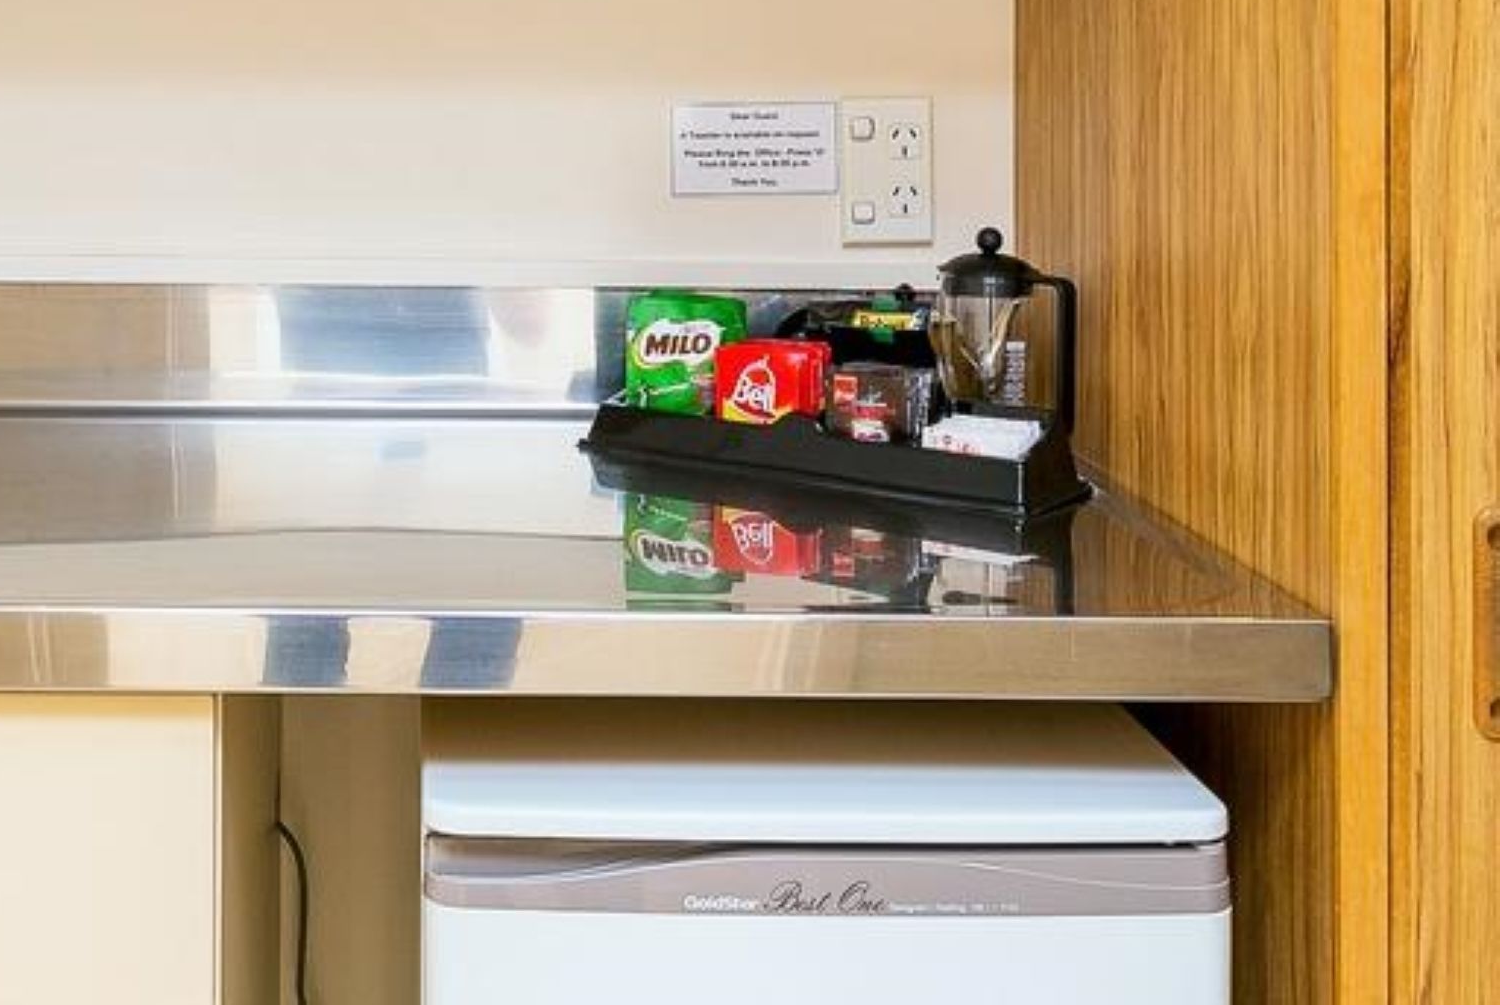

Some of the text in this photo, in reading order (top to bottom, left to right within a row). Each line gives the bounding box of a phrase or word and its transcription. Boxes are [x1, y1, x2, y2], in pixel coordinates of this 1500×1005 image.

[645, 333, 712, 357] MILO
[733, 375, 776, 415] Bell
[763, 880, 832, 913] Best
[836, 880, 887, 913] One
